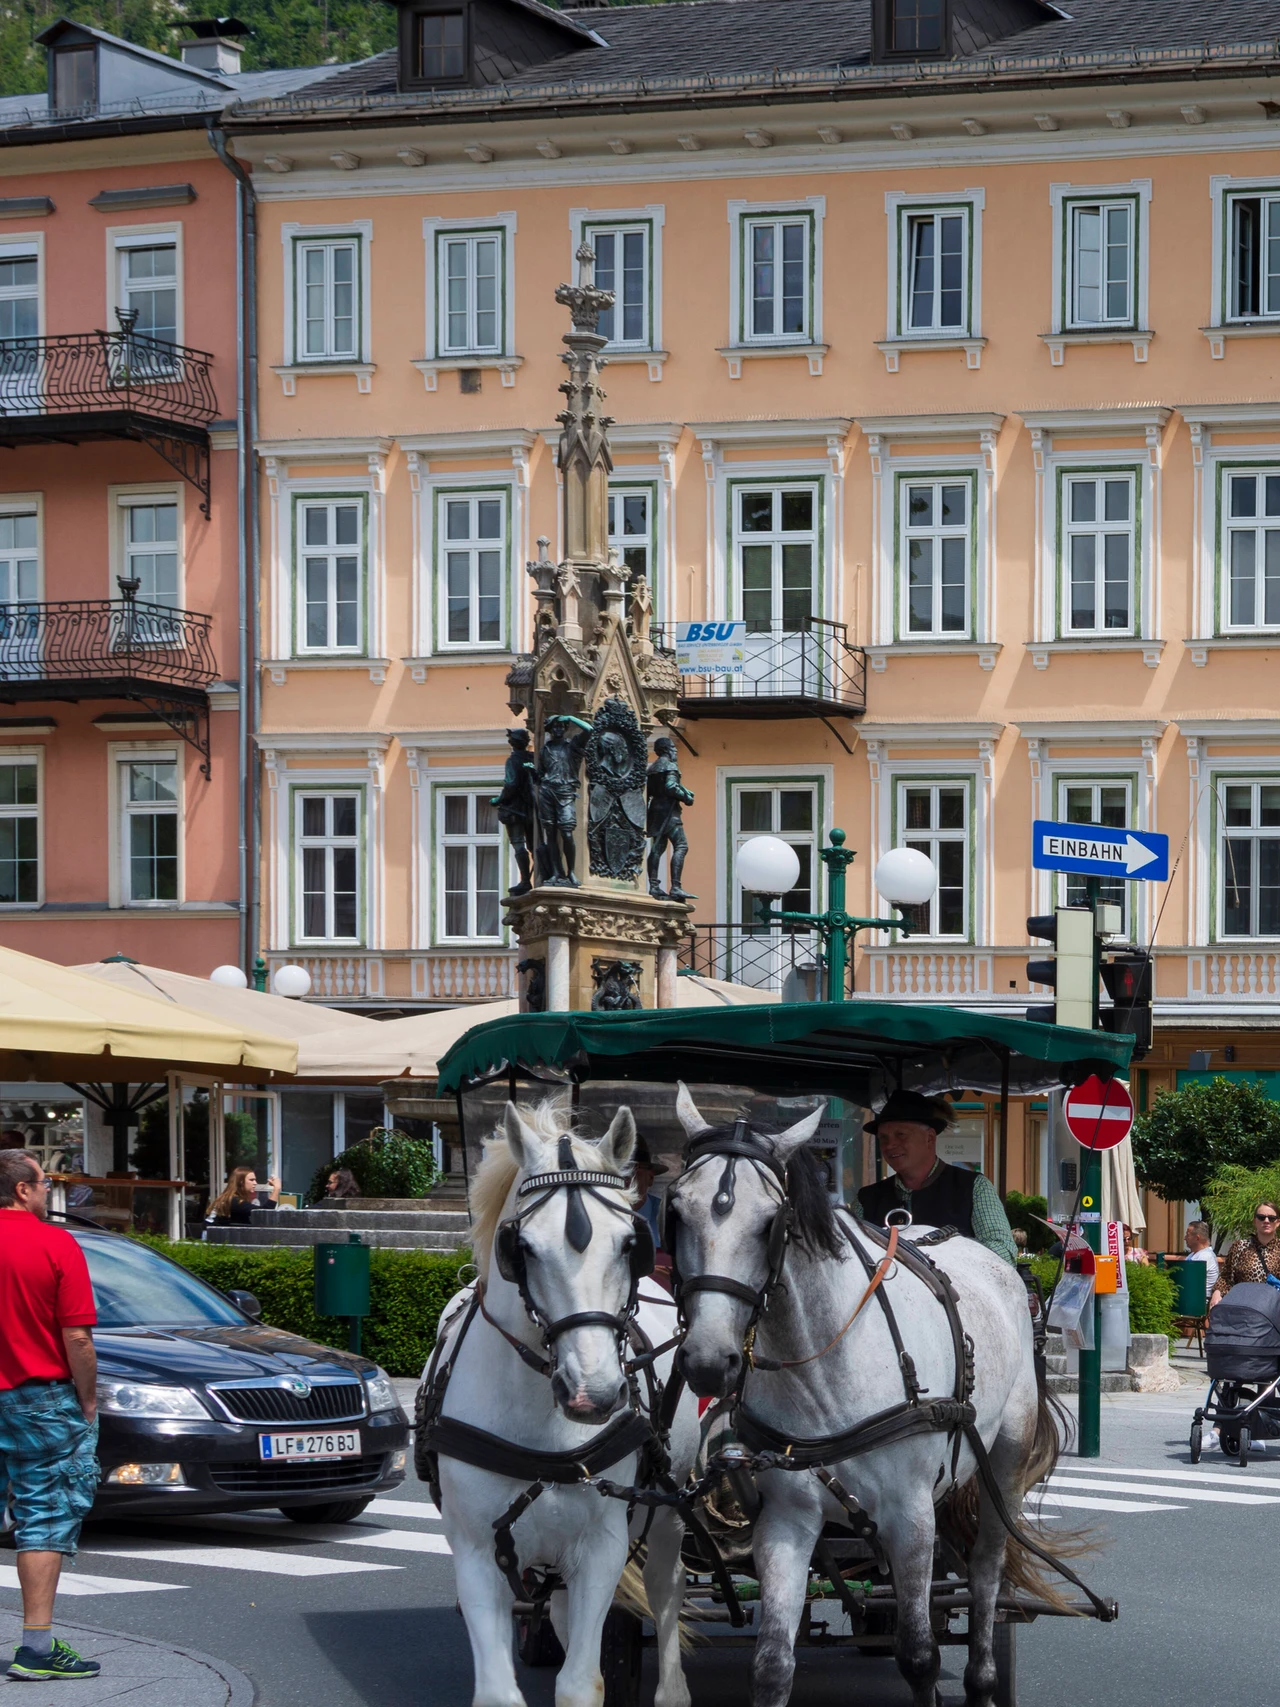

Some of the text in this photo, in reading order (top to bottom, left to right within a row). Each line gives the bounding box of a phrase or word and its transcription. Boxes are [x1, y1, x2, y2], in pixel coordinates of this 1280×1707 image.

[686, 623, 735, 641] BSU
[680, 665, 743, 673] www.bsu-bau.at
[1049, 838, 1122, 861] EINBAHN
[276, 1434, 355, 1455] LF 276 BJ
